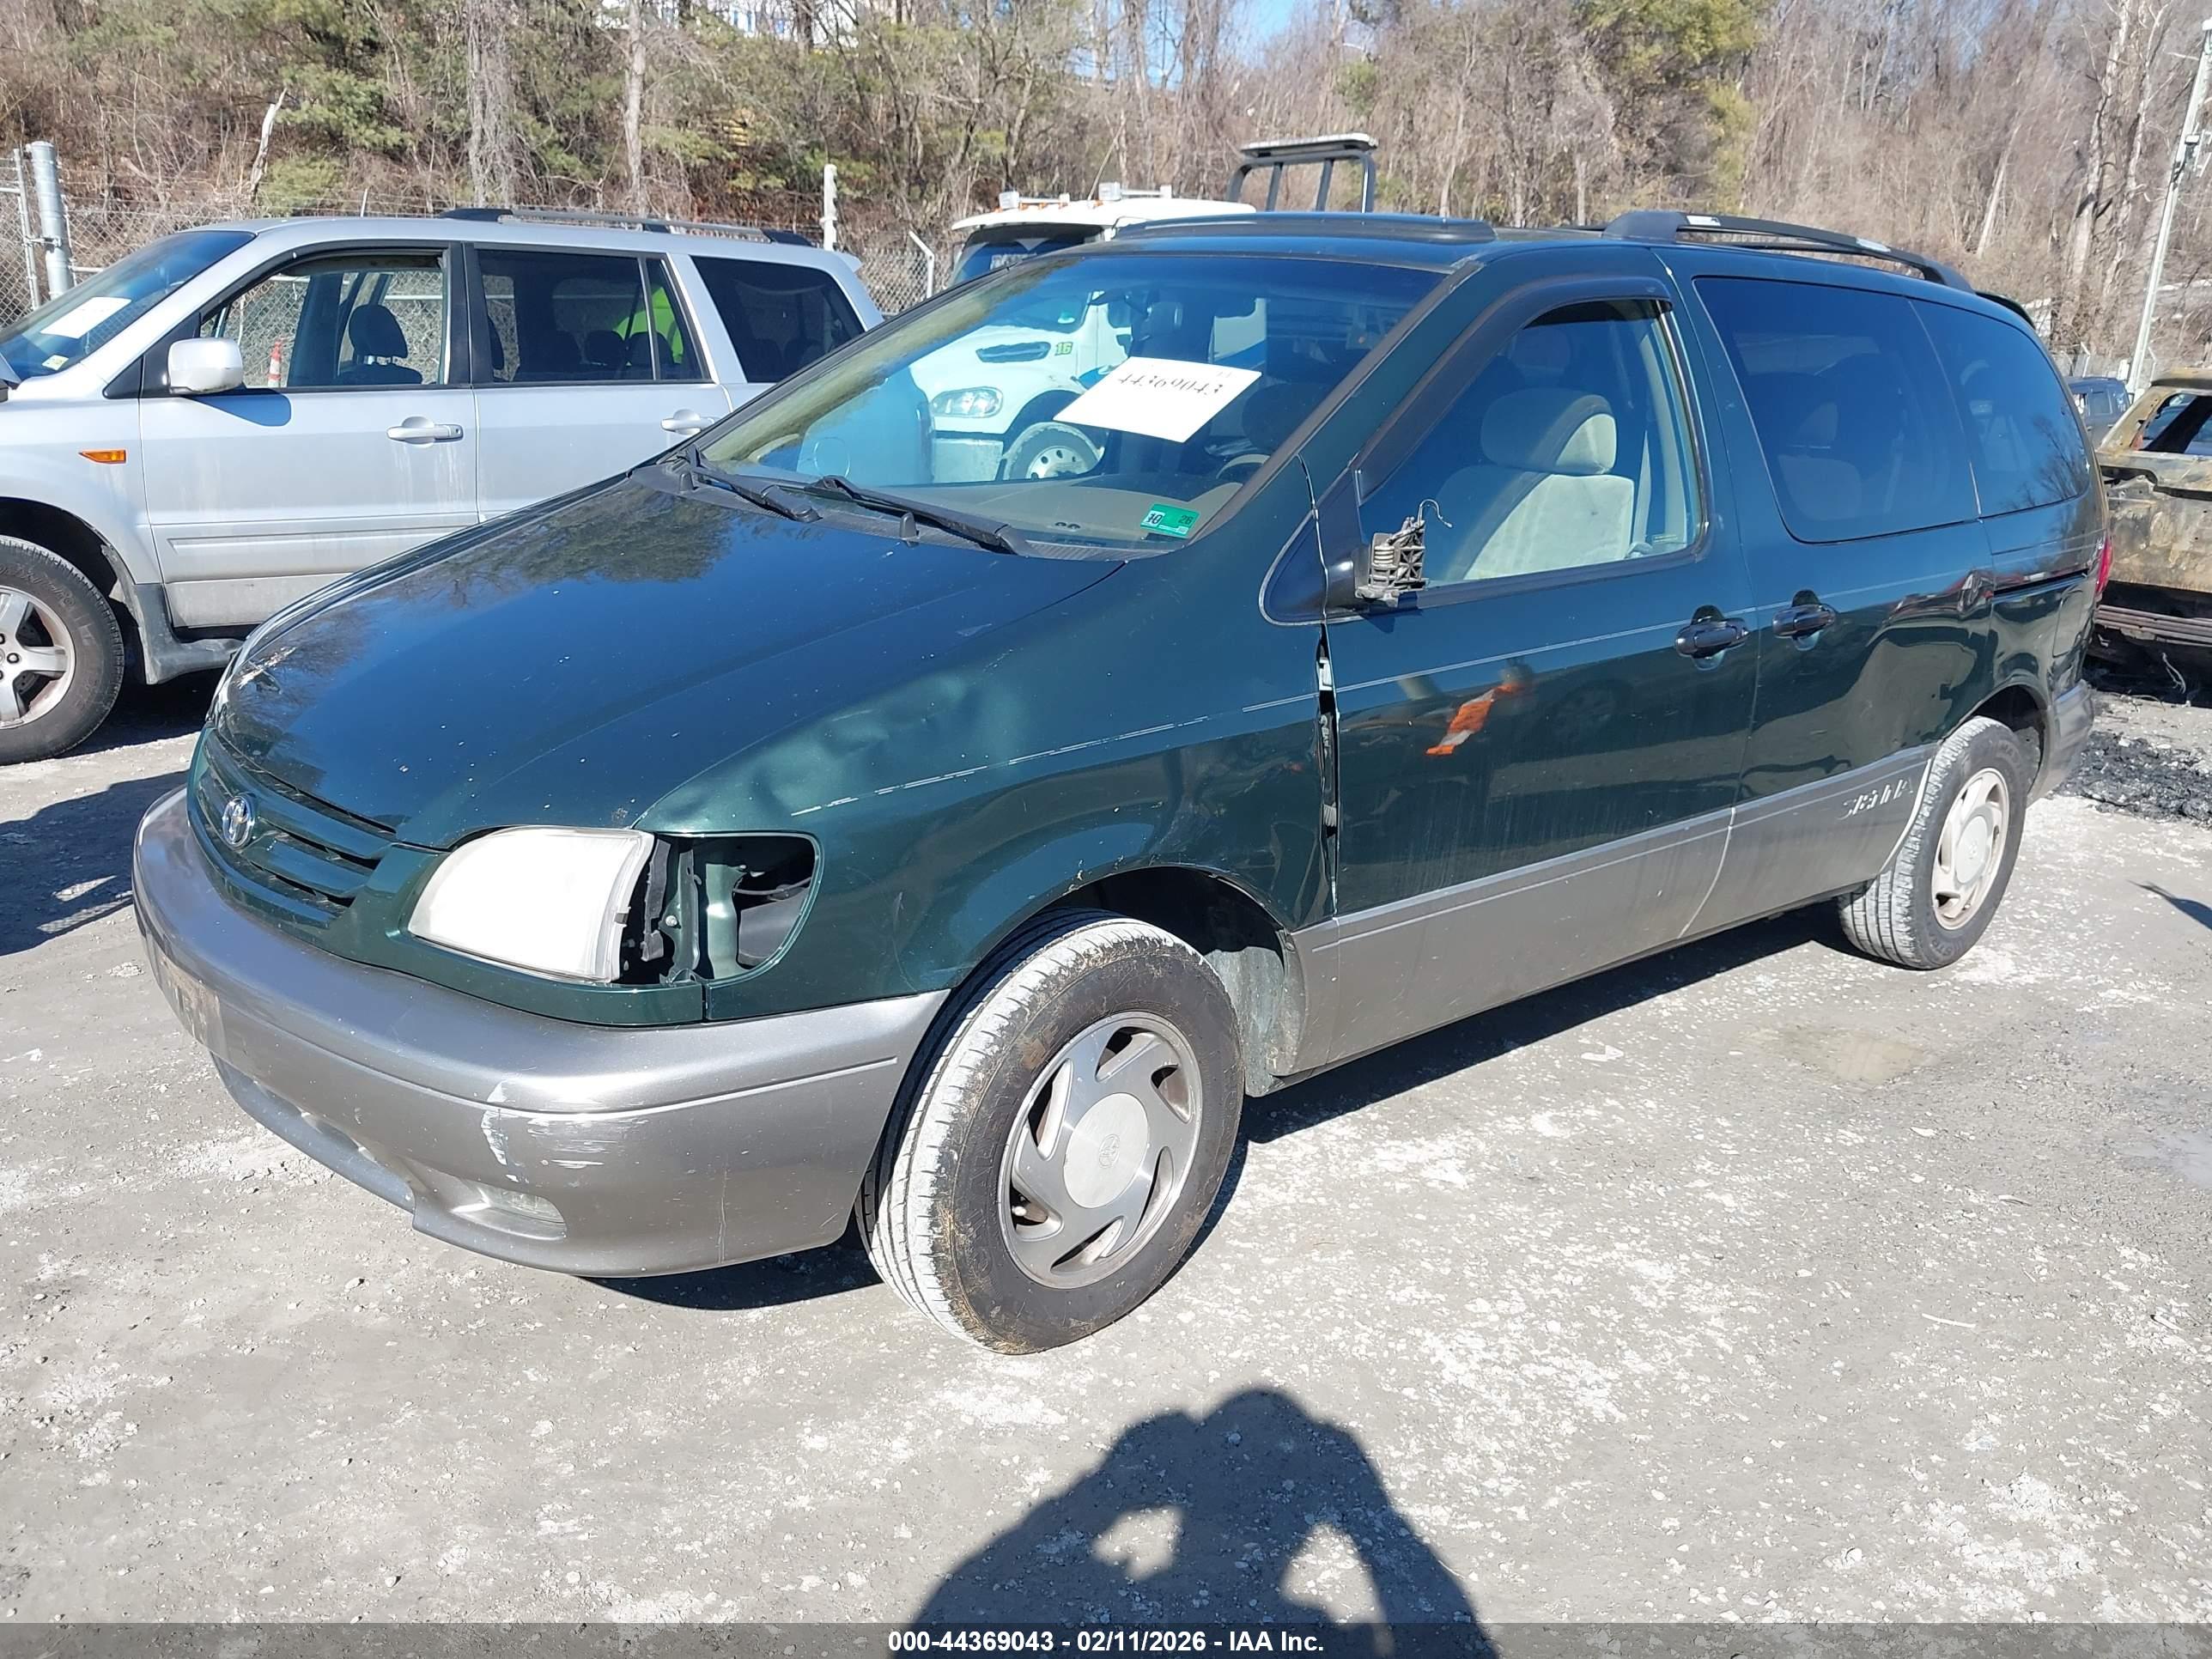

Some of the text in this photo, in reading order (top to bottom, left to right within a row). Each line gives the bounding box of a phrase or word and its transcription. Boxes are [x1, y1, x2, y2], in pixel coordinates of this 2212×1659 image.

[1054, 341, 1073, 356] 16
[1146, 512, 1194, 525] 10 26
